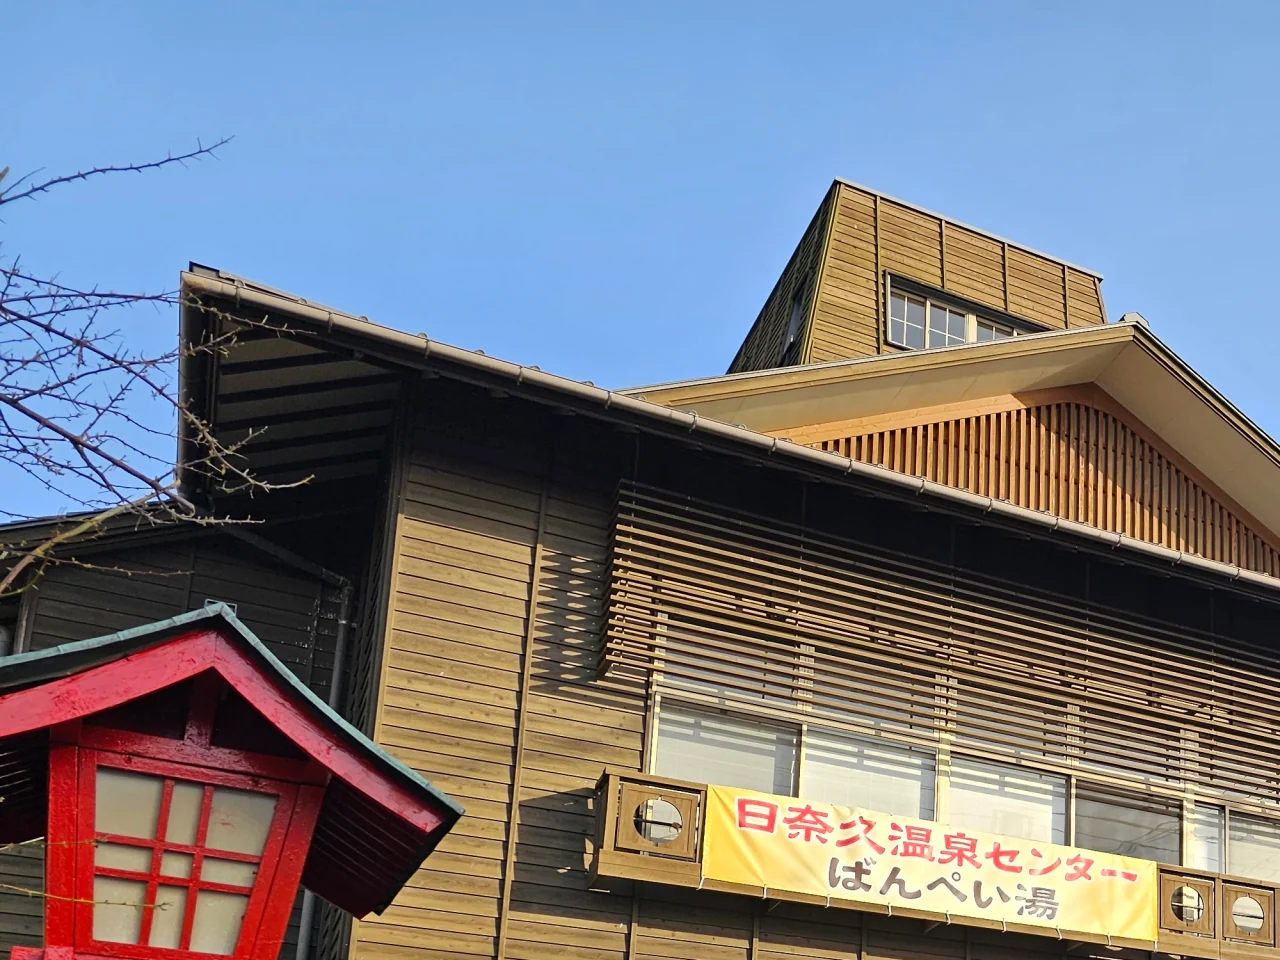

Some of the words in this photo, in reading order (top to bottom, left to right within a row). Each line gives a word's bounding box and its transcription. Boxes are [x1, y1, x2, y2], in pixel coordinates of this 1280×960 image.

[736, 796, 1138, 884] 日奈久温泉センター
[828, 856, 1059, 920] ばんぺい湯
